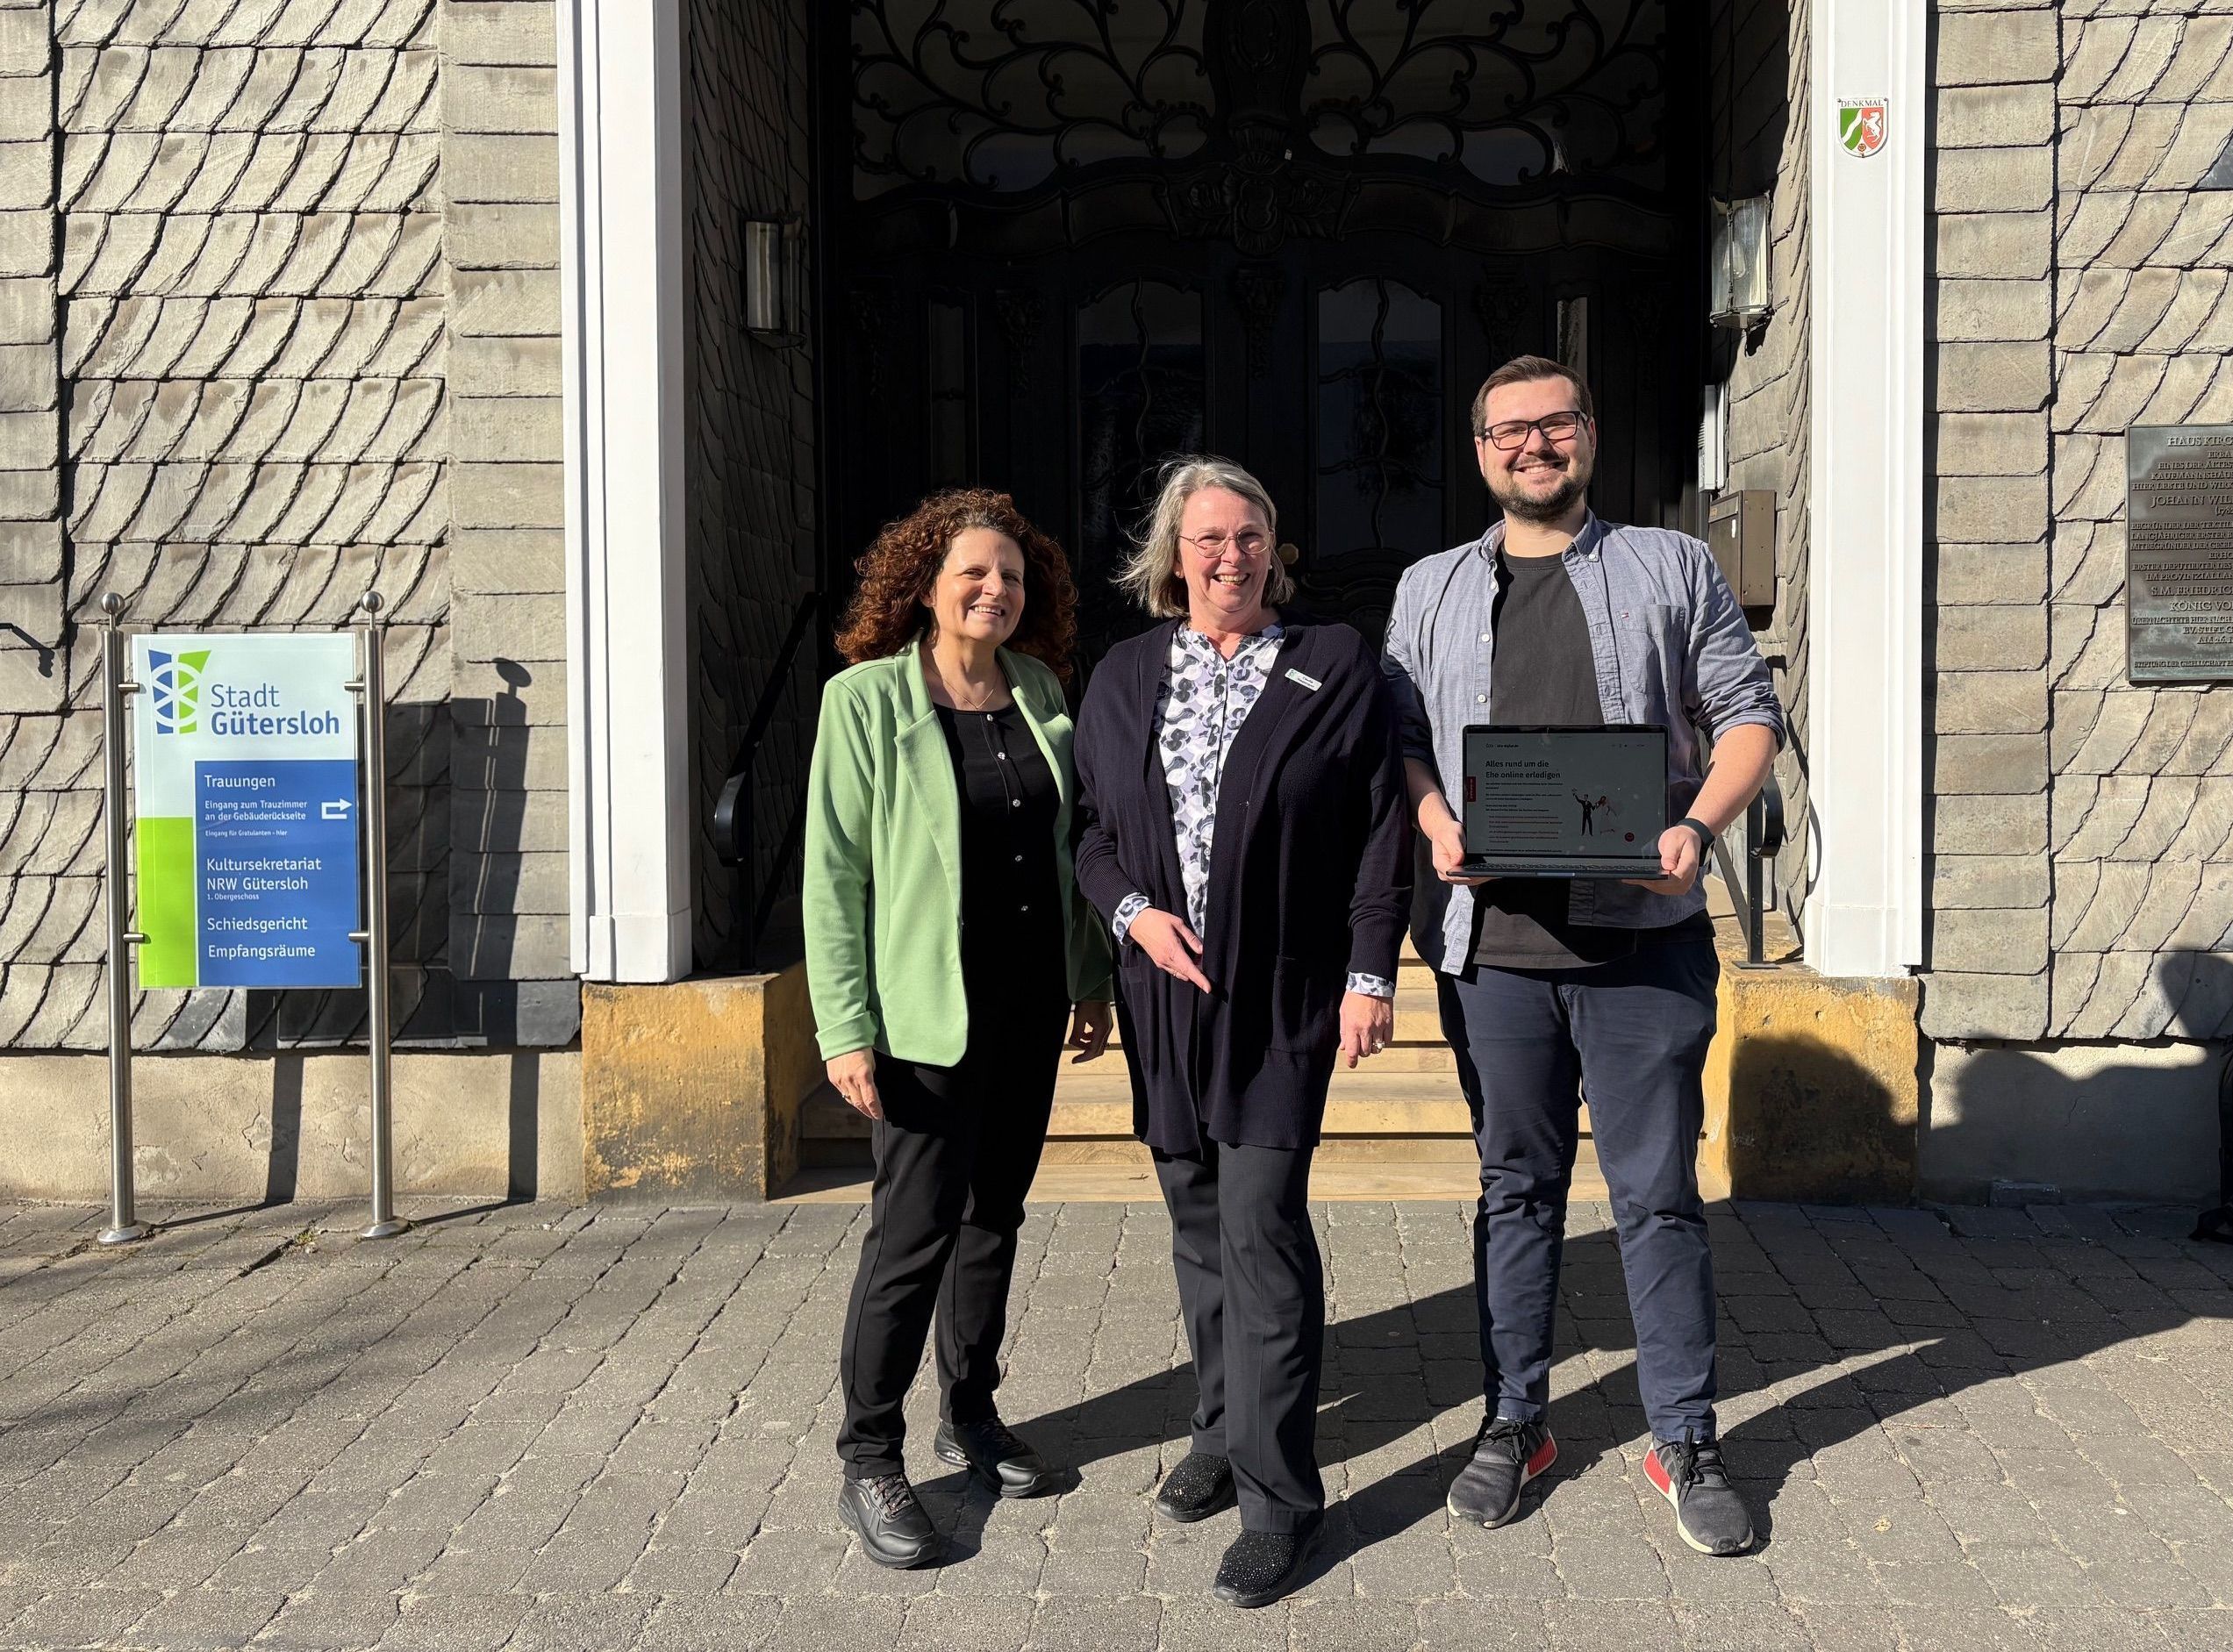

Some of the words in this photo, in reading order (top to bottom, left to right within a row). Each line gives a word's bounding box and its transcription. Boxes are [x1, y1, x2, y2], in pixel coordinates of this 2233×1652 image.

[2167, 436, 2201, 447] HAUS
[2151, 496, 2205, 508] JOHANN
[2130, 521, 2182, 530] BEGRÜNDER
[2131, 532, 2195, 541] LANGJÄHRIGER
[2170, 599, 2211, 611] KÖNIG
[211, 683, 280, 708] Stadt
[211, 711, 340, 735] Gütersloh
[204, 776, 276, 791] Trauungen
[204, 800, 239, 811] Eingang
[260, 799, 308, 809] Trauzimmer
[233, 812, 306, 821] Gebäuderückseite
[206, 857, 322, 872] Kultursekretariat
[207, 877, 238, 890] NRW
[243, 876, 309, 890] Gütersloh
[214, 893, 260, 902] Obergeschoss
[206, 916, 308, 933] Schiedsgericht
[208, 944, 316, 961] Empfangsräume
